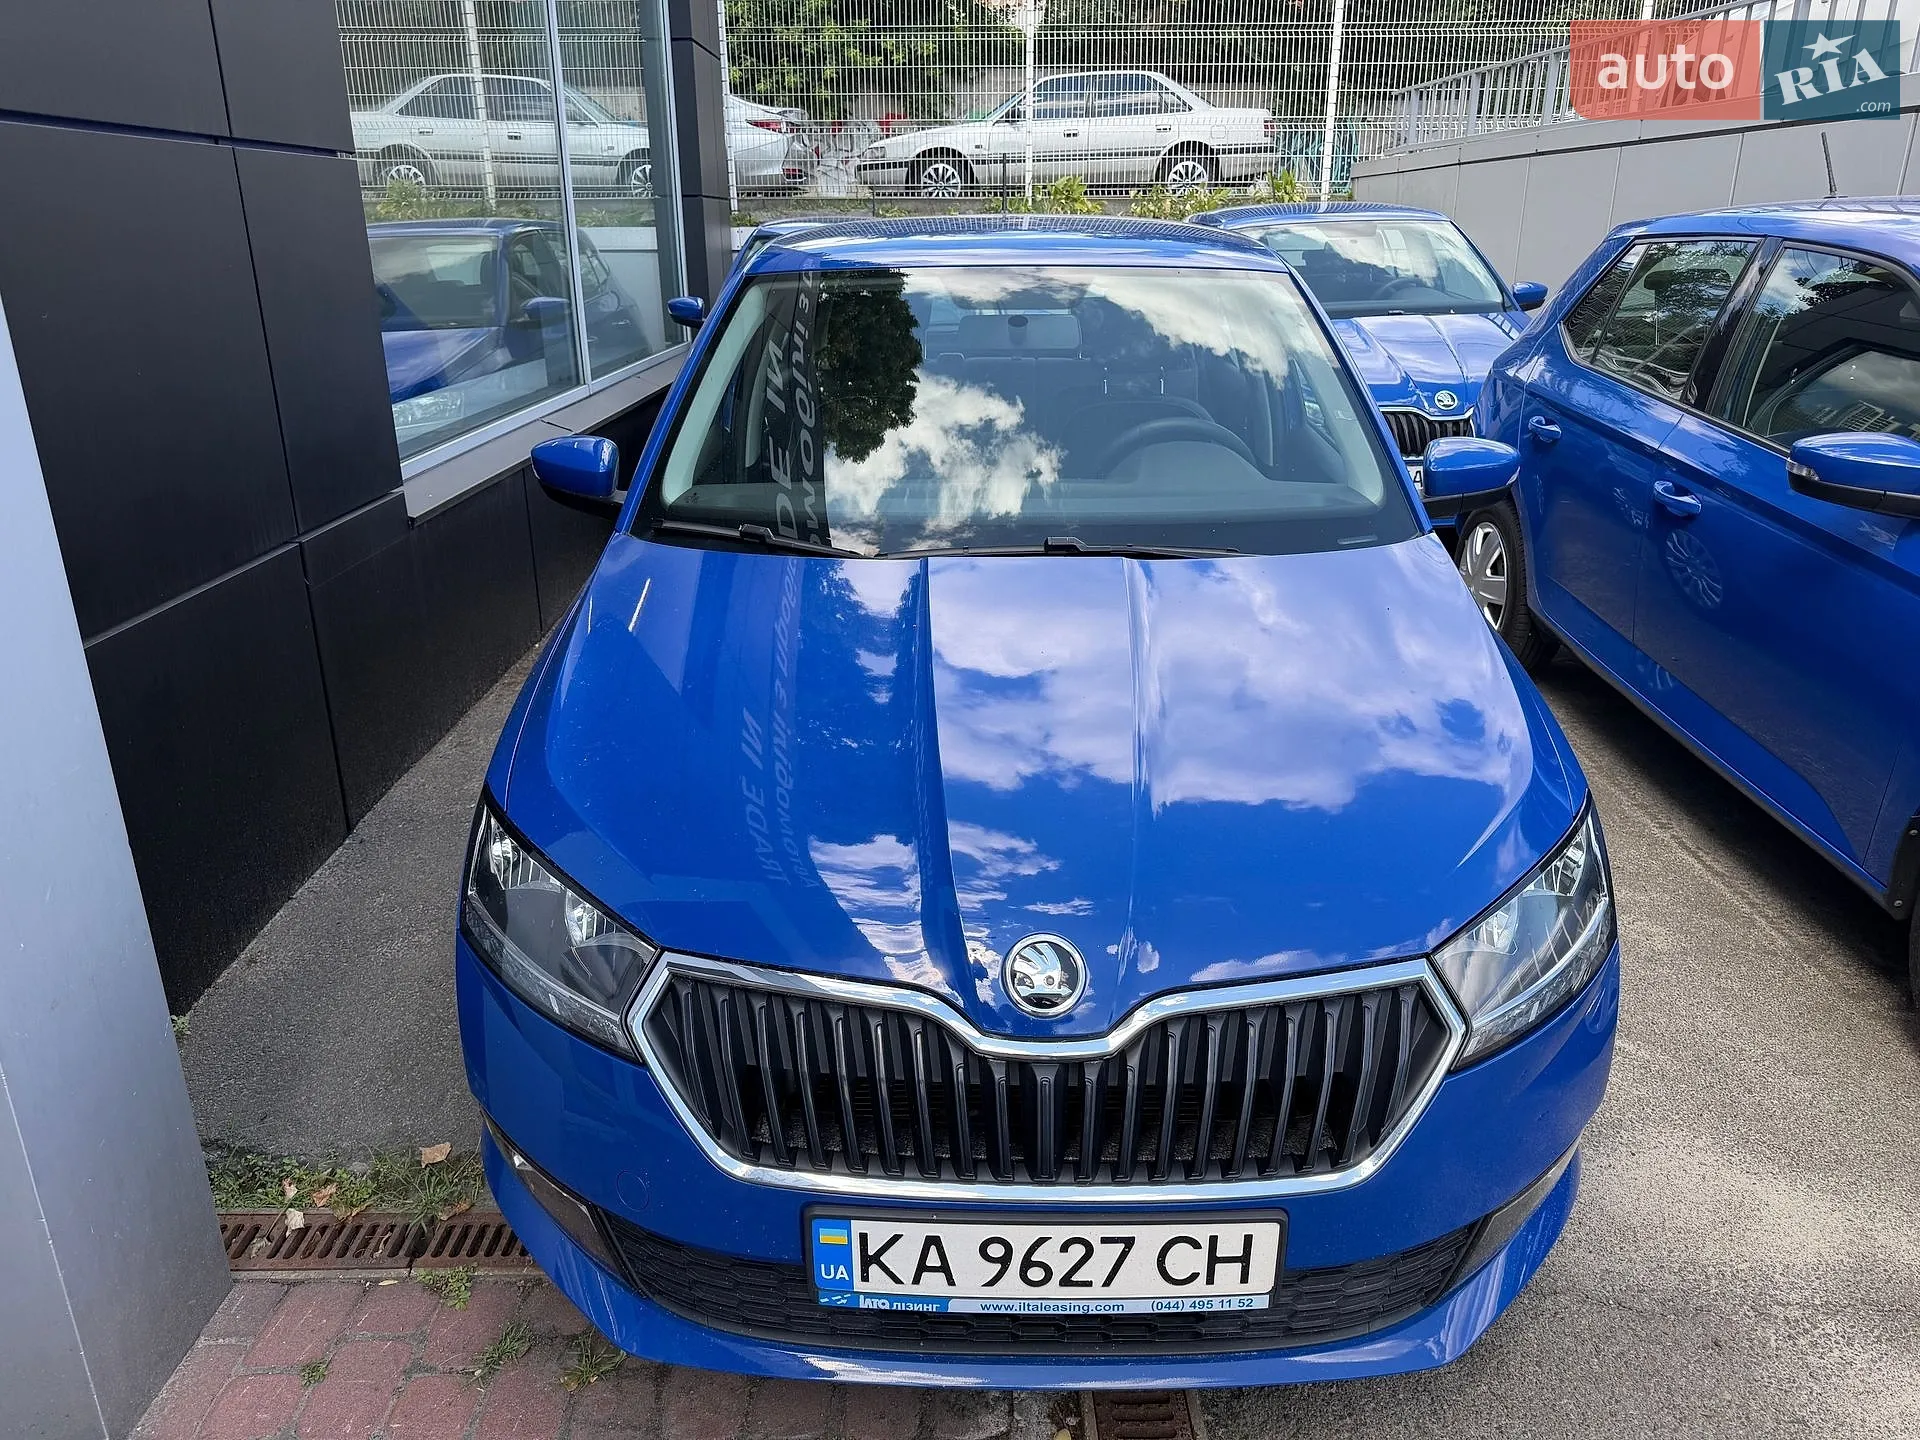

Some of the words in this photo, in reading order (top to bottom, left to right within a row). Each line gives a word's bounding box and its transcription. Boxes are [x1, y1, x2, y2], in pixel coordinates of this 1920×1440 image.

[859, 1231, 956, 1287] KA
[979, 1235, 1136, 1288] 9627
[1156, 1233, 1254, 1286] CH
[820, 1264, 849, 1280] UA
[980, 1301, 1125, 1314] www.iltaleasing.com
[1151, 1299, 1184, 1312] (044)
[1189, 1299, 1214, 1310] 495
[1218, 1299, 1232, 1309] 11
[1237, 1297, 1254, 1308] 52
